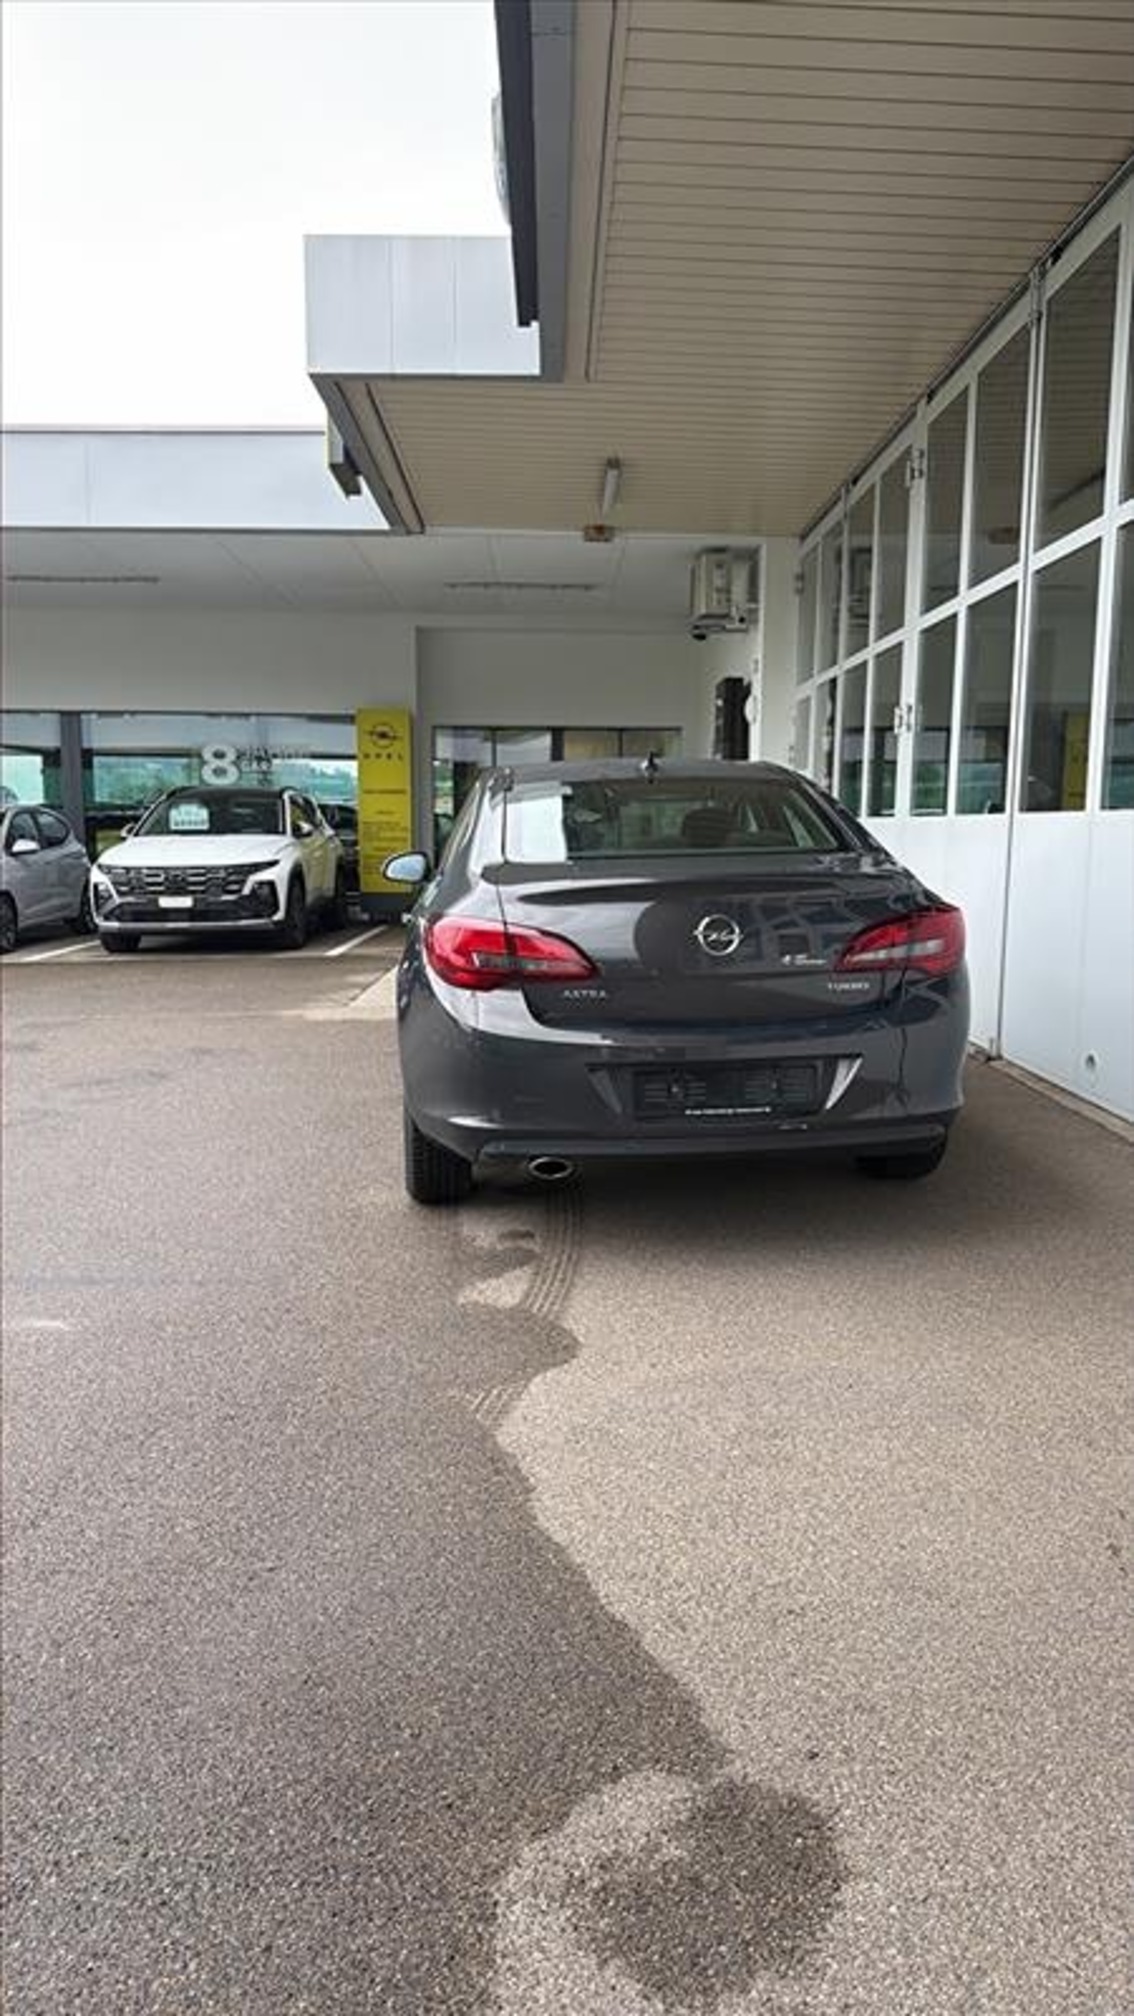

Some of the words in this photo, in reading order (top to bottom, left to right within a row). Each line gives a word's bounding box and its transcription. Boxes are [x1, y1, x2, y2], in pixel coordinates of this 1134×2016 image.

[363, 752, 403, 761] OPEL
[201, 744, 240, 785] 8
[562, 989, 607, 999] ASTRA
